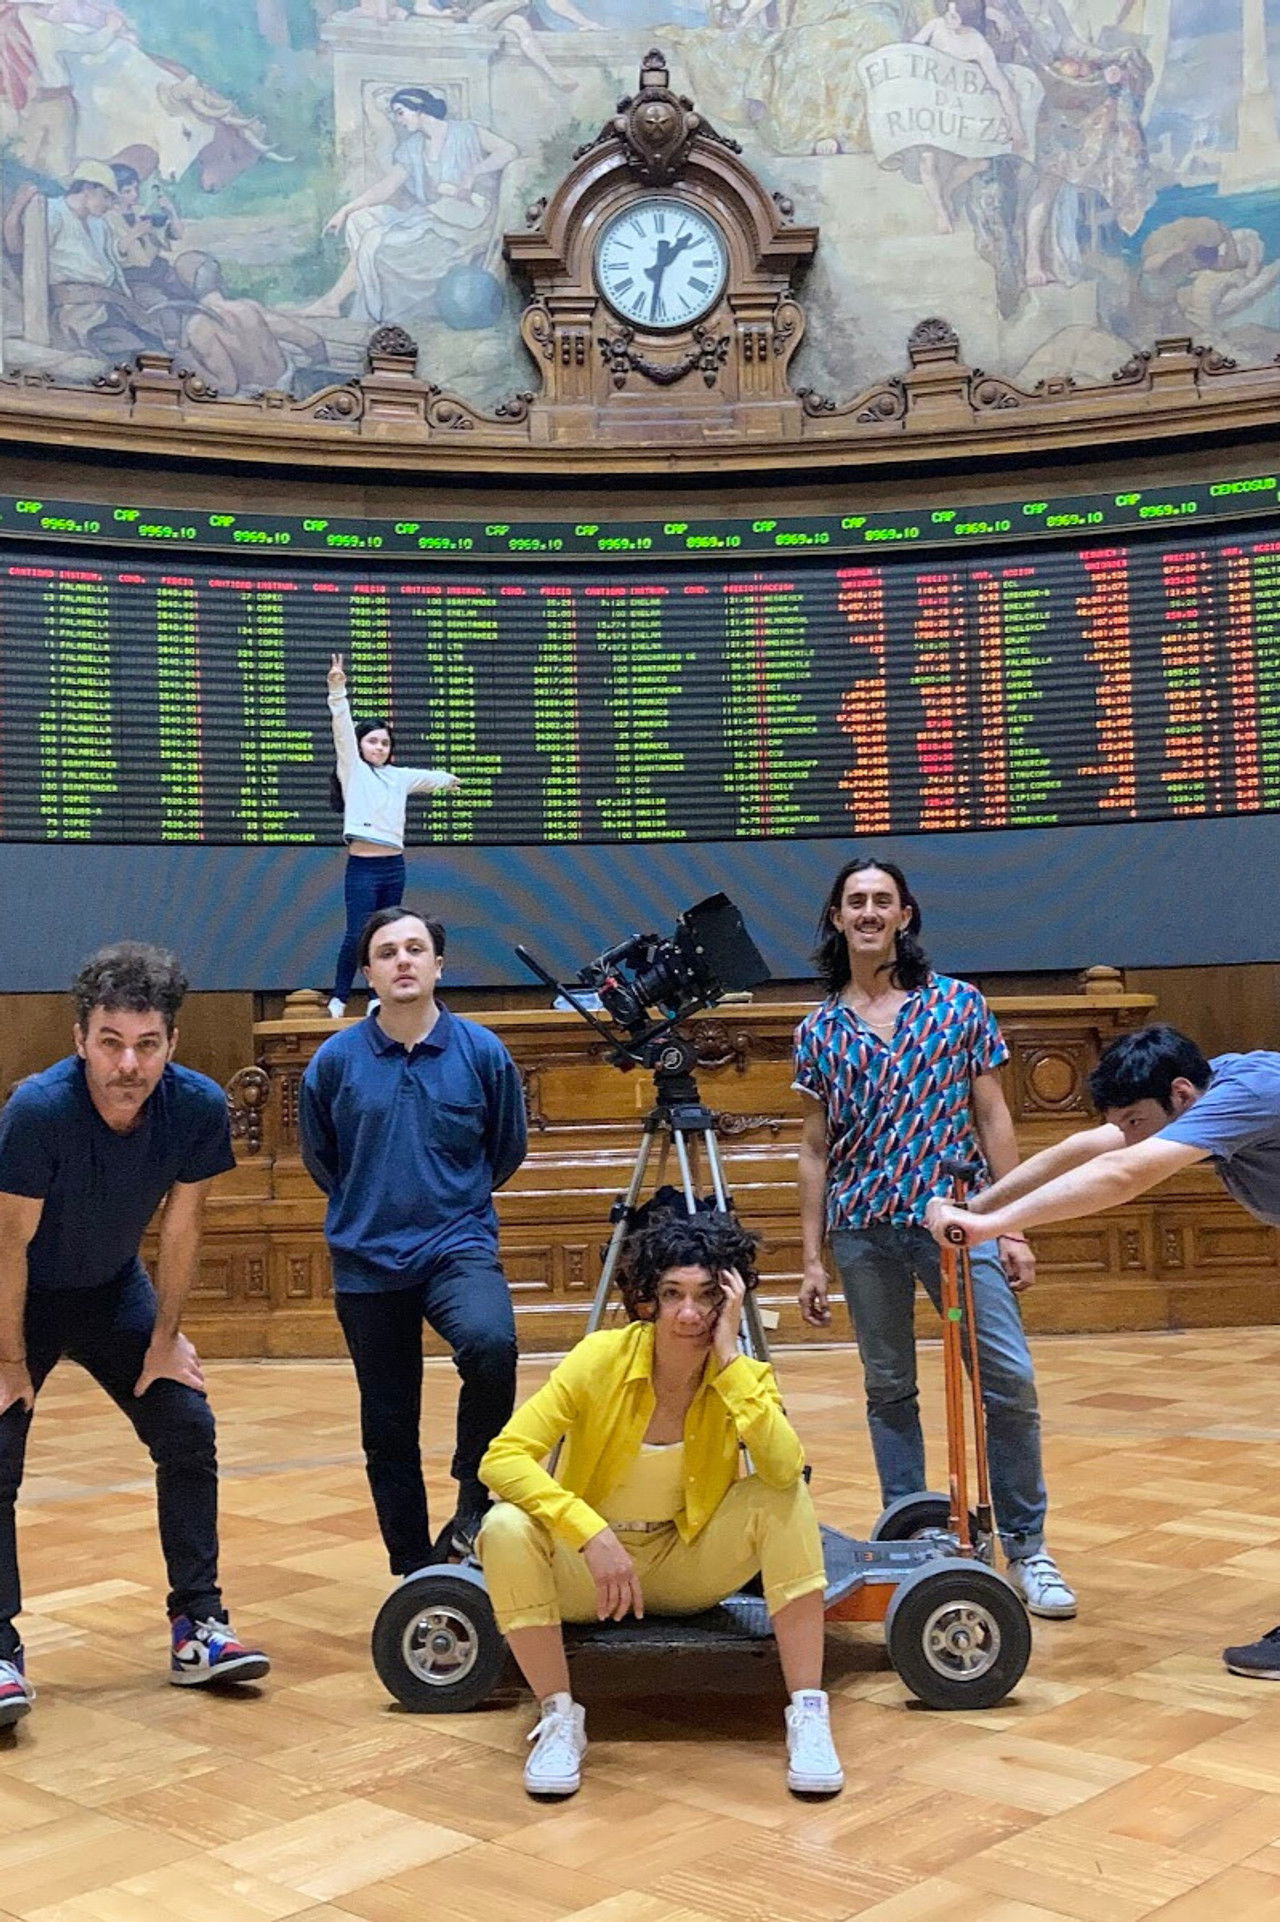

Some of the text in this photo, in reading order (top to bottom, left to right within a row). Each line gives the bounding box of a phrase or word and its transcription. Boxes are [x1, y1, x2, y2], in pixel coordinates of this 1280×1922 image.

[865, 58, 900, 88] EL
[887, 107, 1014, 145] RIQUEZA
[1115, 493, 1142, 507] CAP
[16, 501, 43, 513] CAP
[1023, 503, 1049, 515] CAP
[113, 509, 141, 521] CAP
[931, 511, 957, 523] CAP
[209, 515, 236, 528] CAP
[303, 519, 329, 532] CAP
[752, 521, 777, 532] CAP
[841, 517, 867, 529] CAP
[394, 523, 421, 534] CAP
[485, 525, 510, 536] CAP
[575, 525, 599, 536] CAP
[664, 522, 688, 535] CAP
